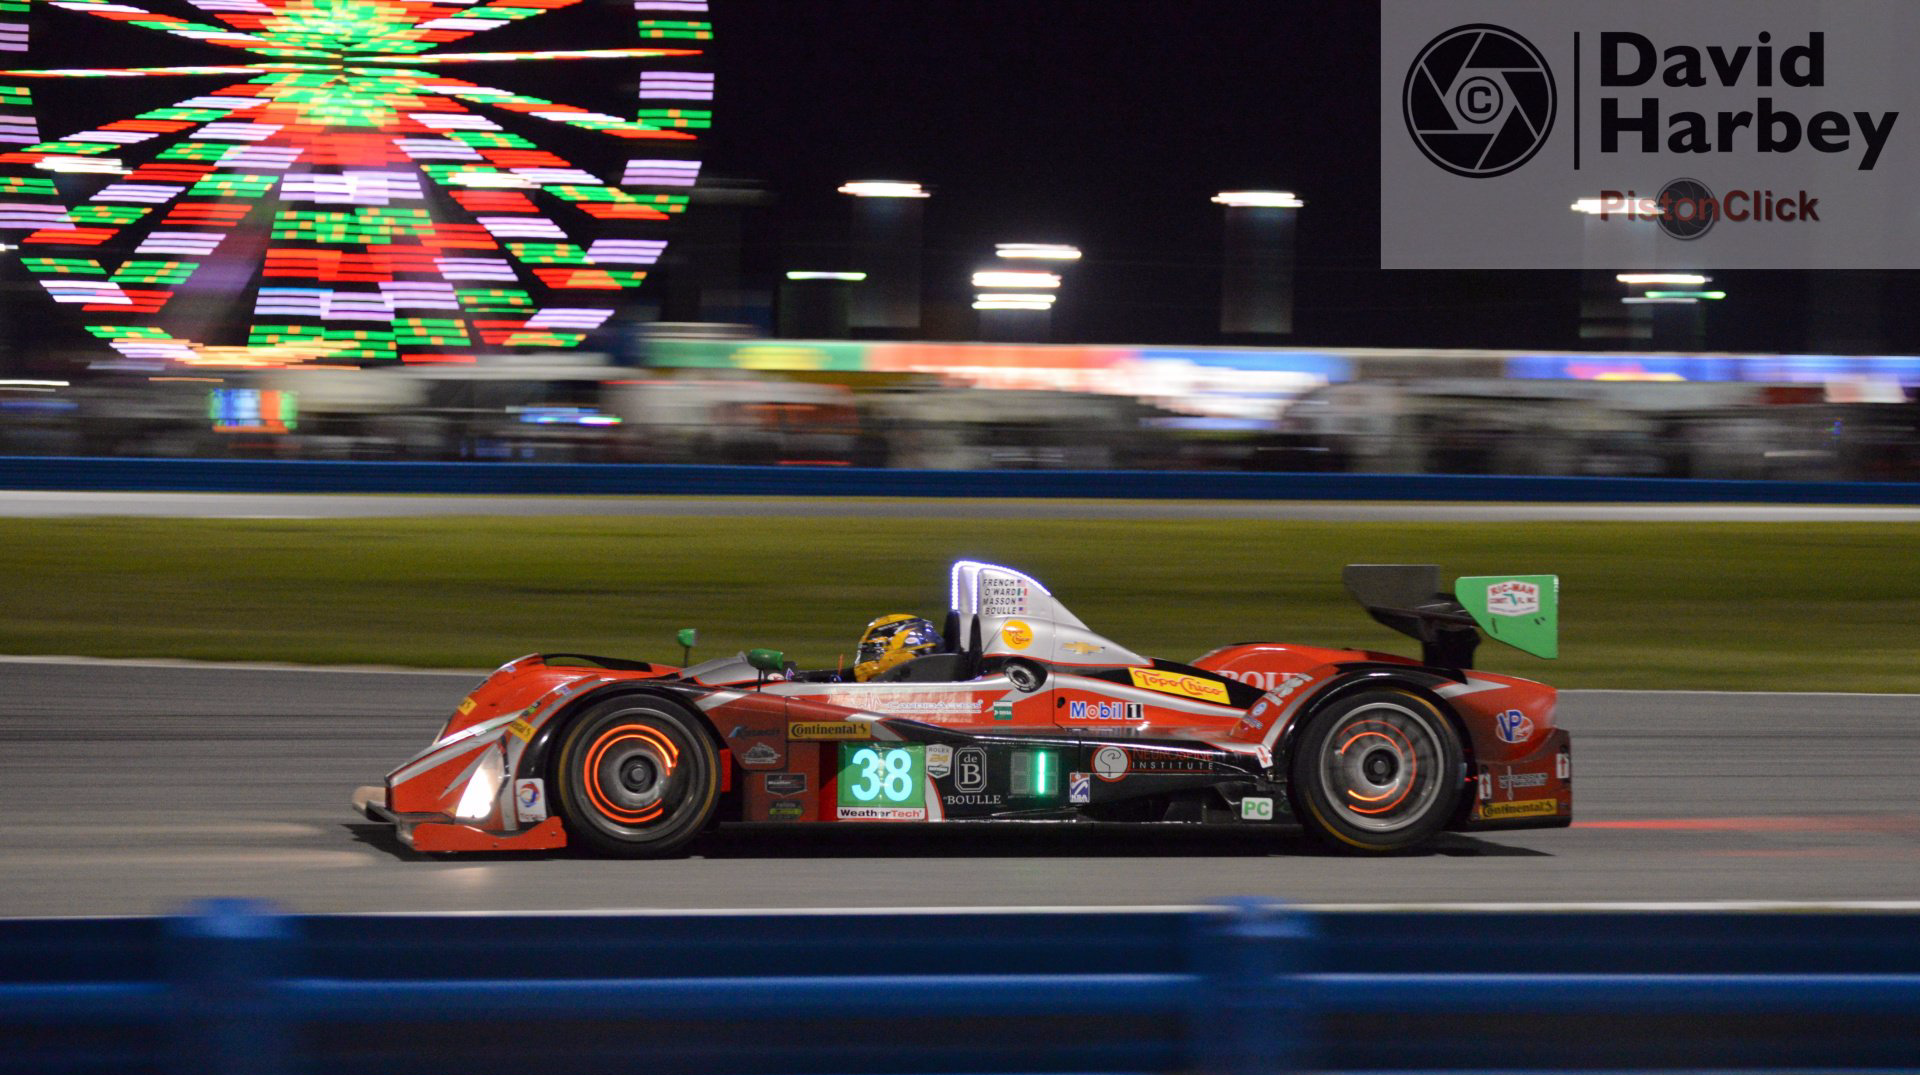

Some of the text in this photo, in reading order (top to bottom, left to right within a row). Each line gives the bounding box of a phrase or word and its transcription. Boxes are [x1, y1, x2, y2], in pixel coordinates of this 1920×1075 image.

[983, 579, 1015, 587] FRENCH
[983, 597, 1016, 605] MASSON
[984, 606, 1017, 615] BOULLE
[1070, 701, 1122, 719] Mobil
[791, 723, 857, 737] Continental
[963, 754, 978, 763] de
[1131, 761, 1213, 770] INSTITUTE
[852, 748, 912, 801] 38
[961, 763, 981, 785] B
[947, 794, 1001, 805] BOULLE
[840, 808, 920, 818] WeatherTech
[1244, 801, 1270, 816] PC
